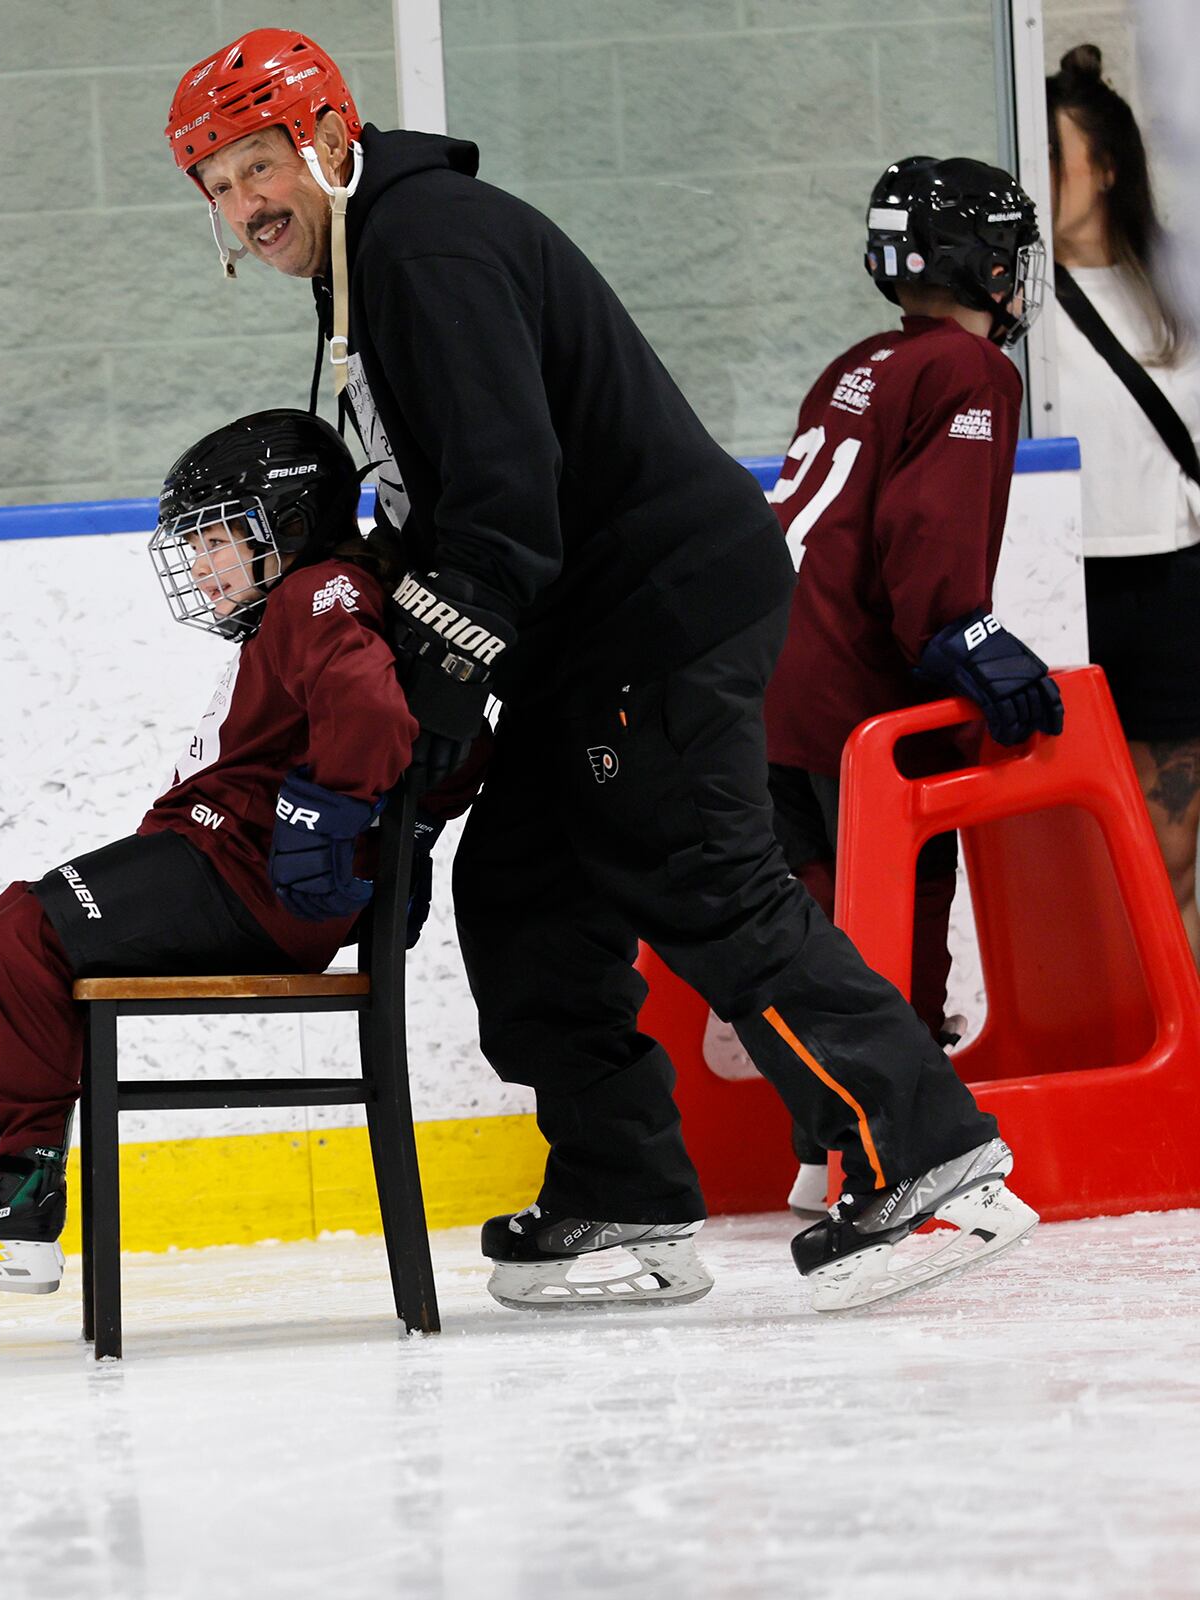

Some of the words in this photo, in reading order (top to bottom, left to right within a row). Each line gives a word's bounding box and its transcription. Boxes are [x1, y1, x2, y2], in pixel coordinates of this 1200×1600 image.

[174, 111, 211, 139] BAUER
[267, 464, 318, 480] BAUER
[963, 613, 1001, 651] BA
[190, 803, 225, 831] GW
[275, 794, 321, 831] ER
[58, 864, 102, 920] BAUER
